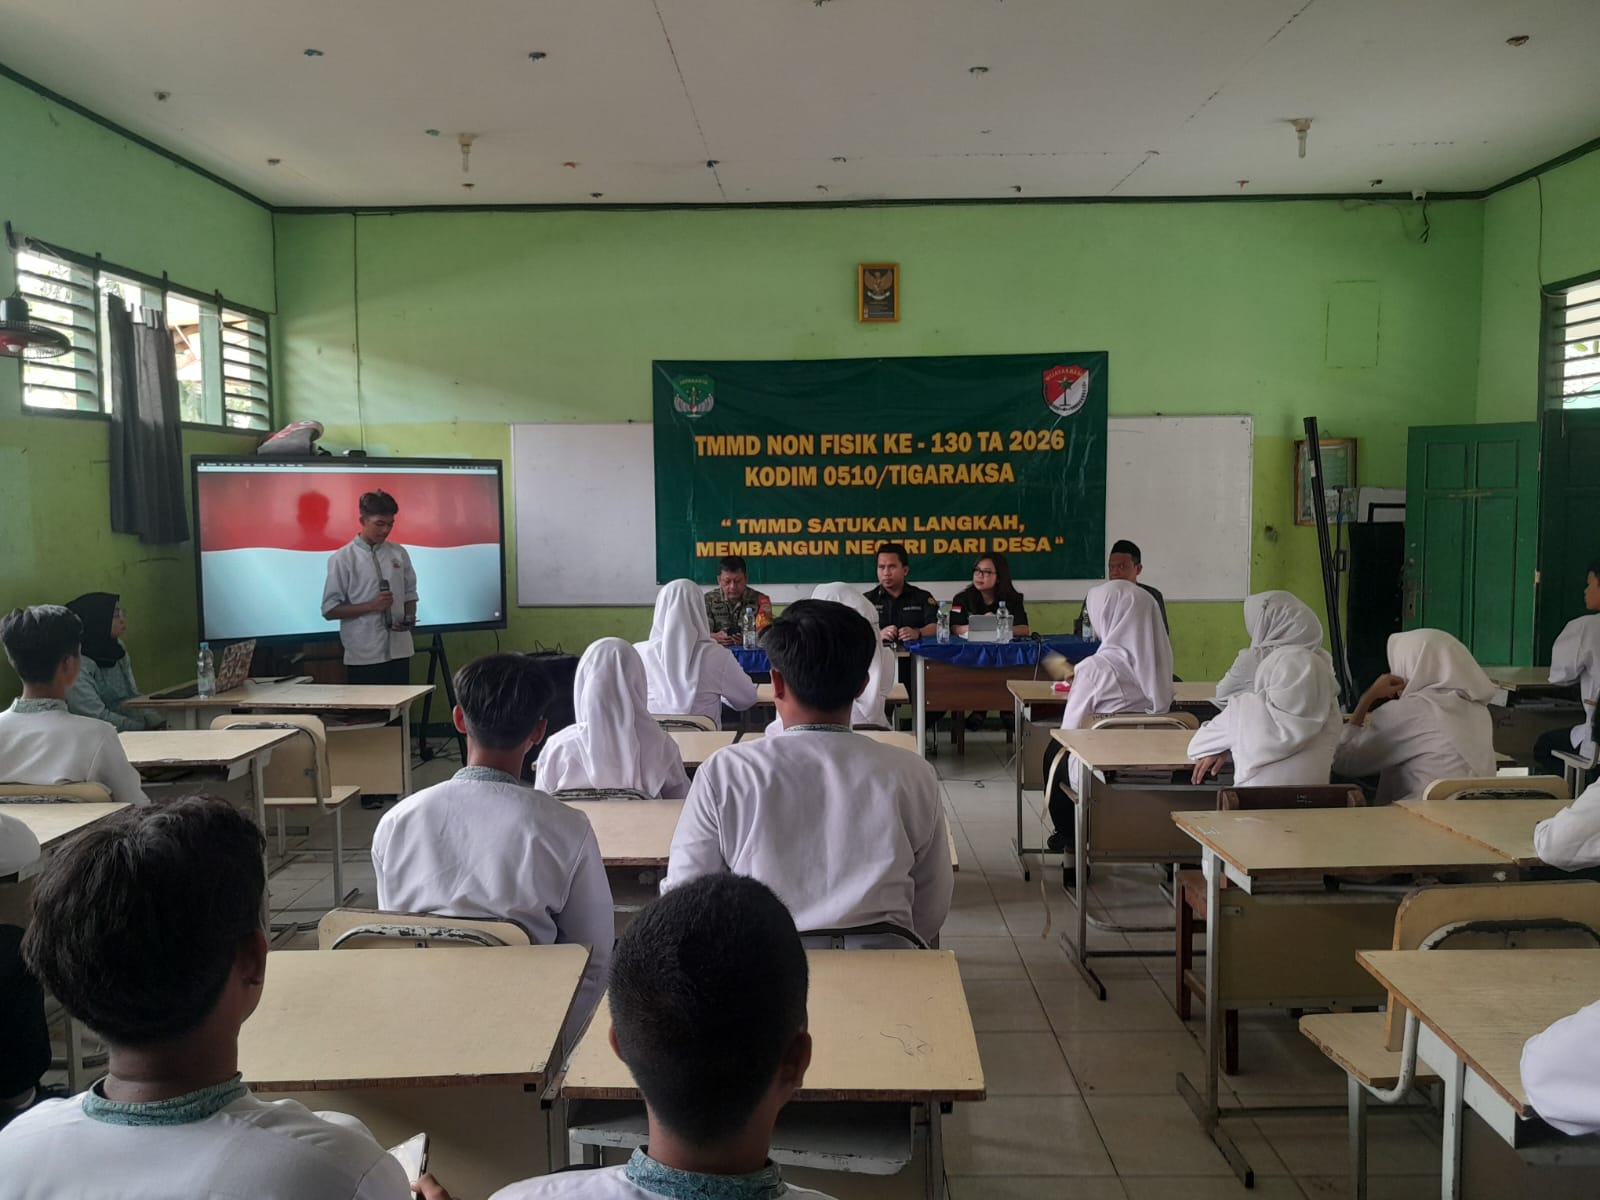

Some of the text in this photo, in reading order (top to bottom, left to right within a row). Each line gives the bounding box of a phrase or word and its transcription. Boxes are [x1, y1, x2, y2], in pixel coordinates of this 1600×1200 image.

[694, 435, 761, 456] TMMD
[767, 434, 814, 456] NON
[820, 433, 878, 455] FISIK
[883, 433, 913, 454] KE
[931, 431, 972, 453] 130
[977, 431, 1004, 452] TA
[1009, 429, 1065, 451] 2026
[745, 462, 1015, 489] KODIM 0510/TIGARAKSA
[736, 518, 803, 534] TMMD
[807, 517, 907, 534] SATUKAN
[913, 514, 1025, 532] LANGKAH,
[696, 540, 839, 557] MEMBANGUN
[845, 539, 927, 555] NERI
[933, 537, 987, 554] DARI
[992, 536, 1052, 553] DESA
